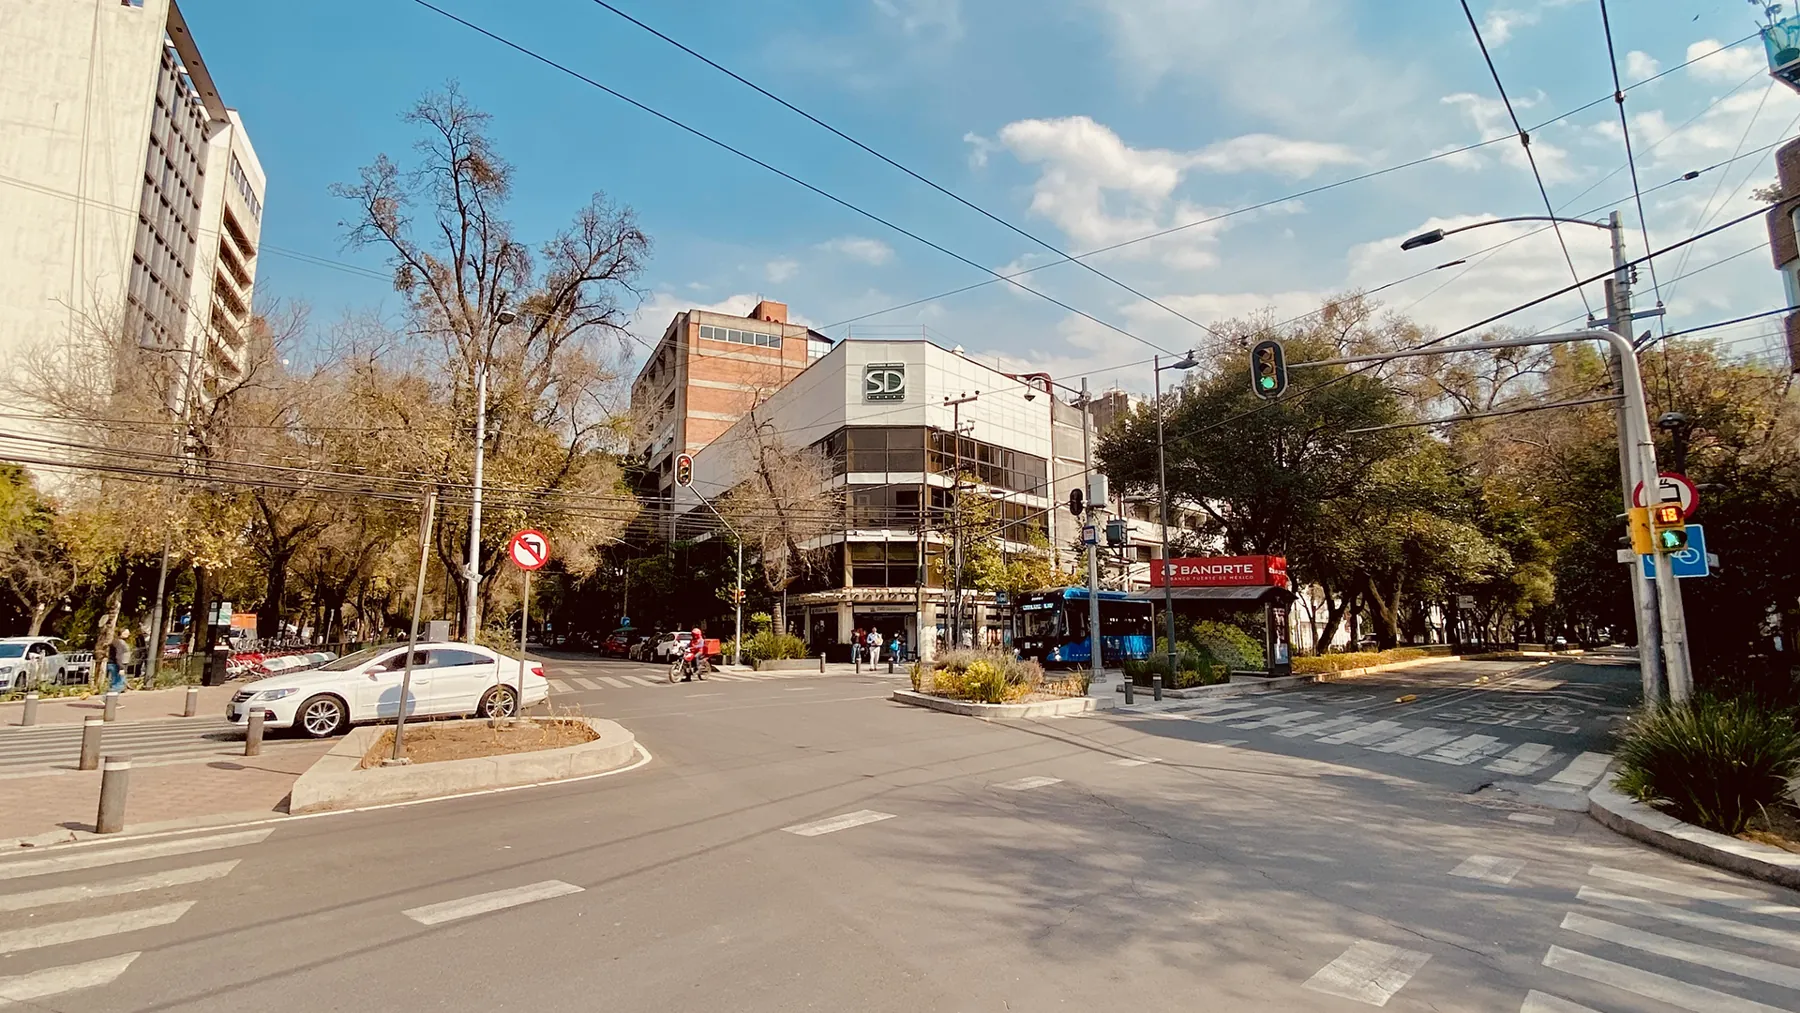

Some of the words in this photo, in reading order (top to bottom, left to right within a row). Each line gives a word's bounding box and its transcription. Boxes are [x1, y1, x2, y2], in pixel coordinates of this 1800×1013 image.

[866, 370, 904, 393] SD
[1661, 507, 1678, 522] 18
[1180, 564, 1254, 575] BANORTE
